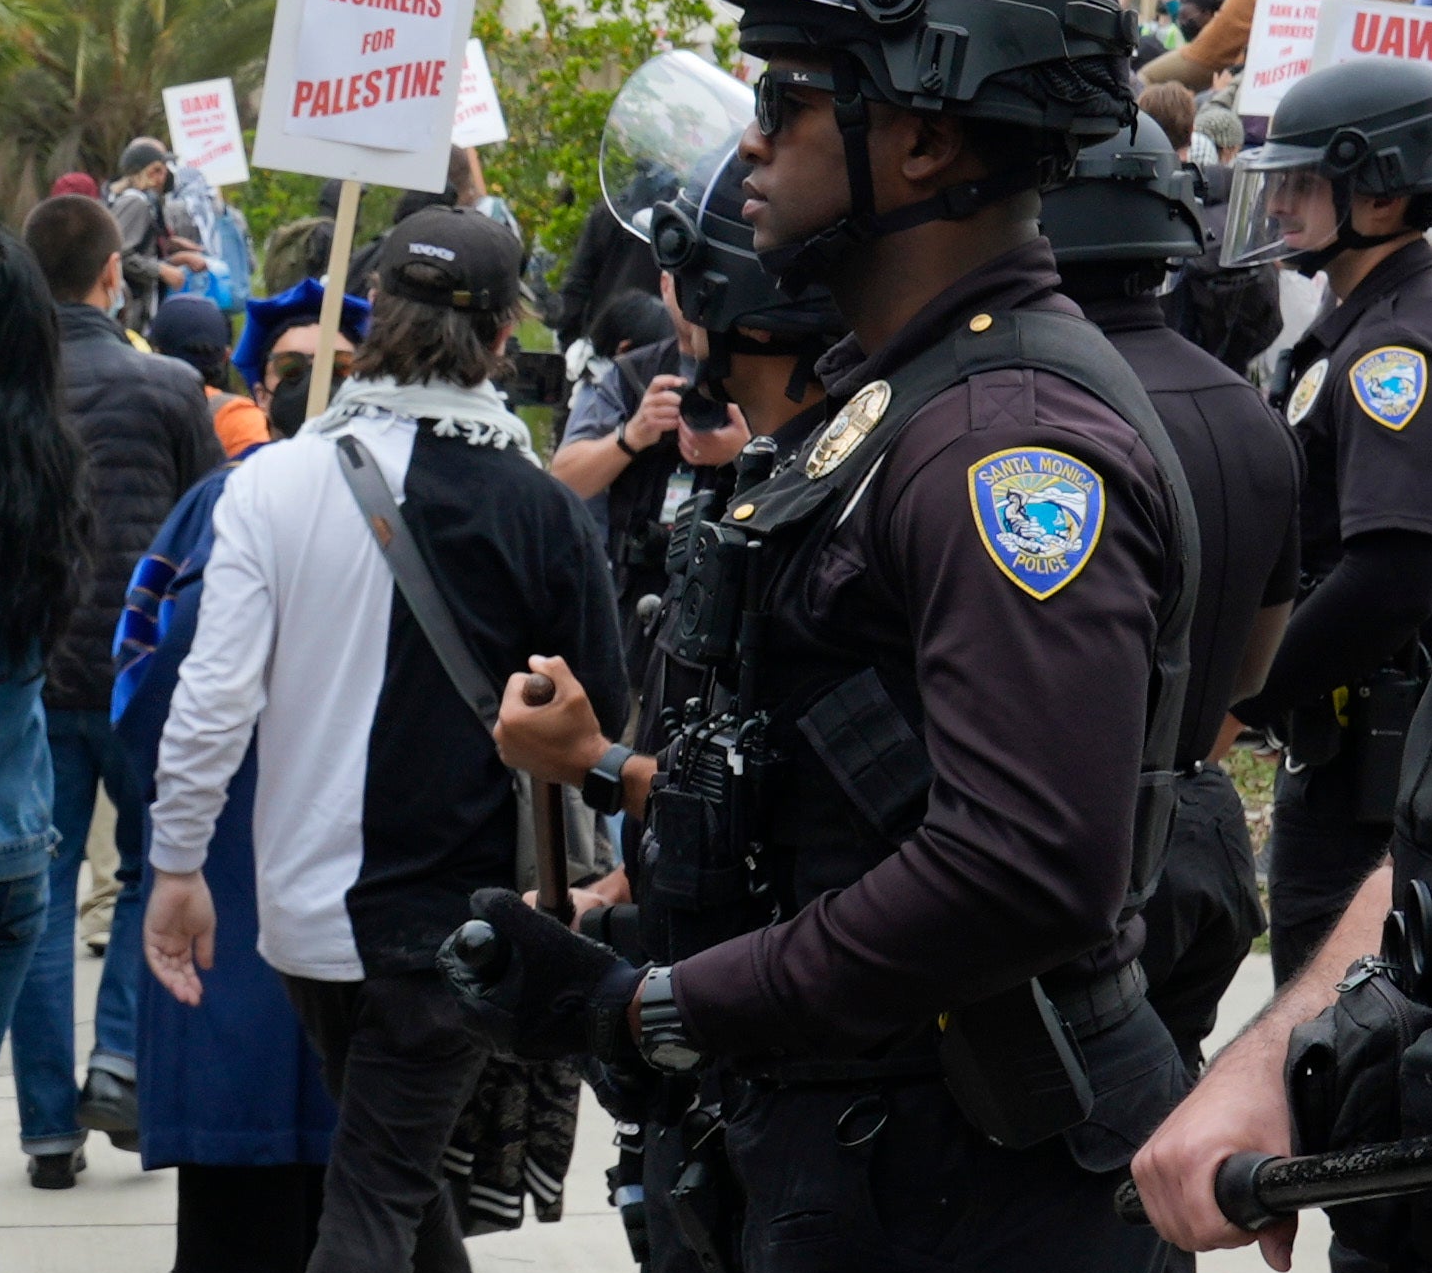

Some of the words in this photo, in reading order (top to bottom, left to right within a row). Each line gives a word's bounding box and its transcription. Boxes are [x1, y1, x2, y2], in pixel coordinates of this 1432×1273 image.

[1303, 6, 1319, 20] FIL
[362, 28, 395, 55] FOR
[1268, 24, 1314, 39] WORKERS
[1253, 58, 1313, 88] PALESTIN
[291, 60, 447, 118] PALESTINE
[181, 93, 220, 114] UAW
[979, 457, 1032, 485] SANTA
[1040, 456, 1095, 494] MONICA
[1013, 553, 1070, 575] POLICE
